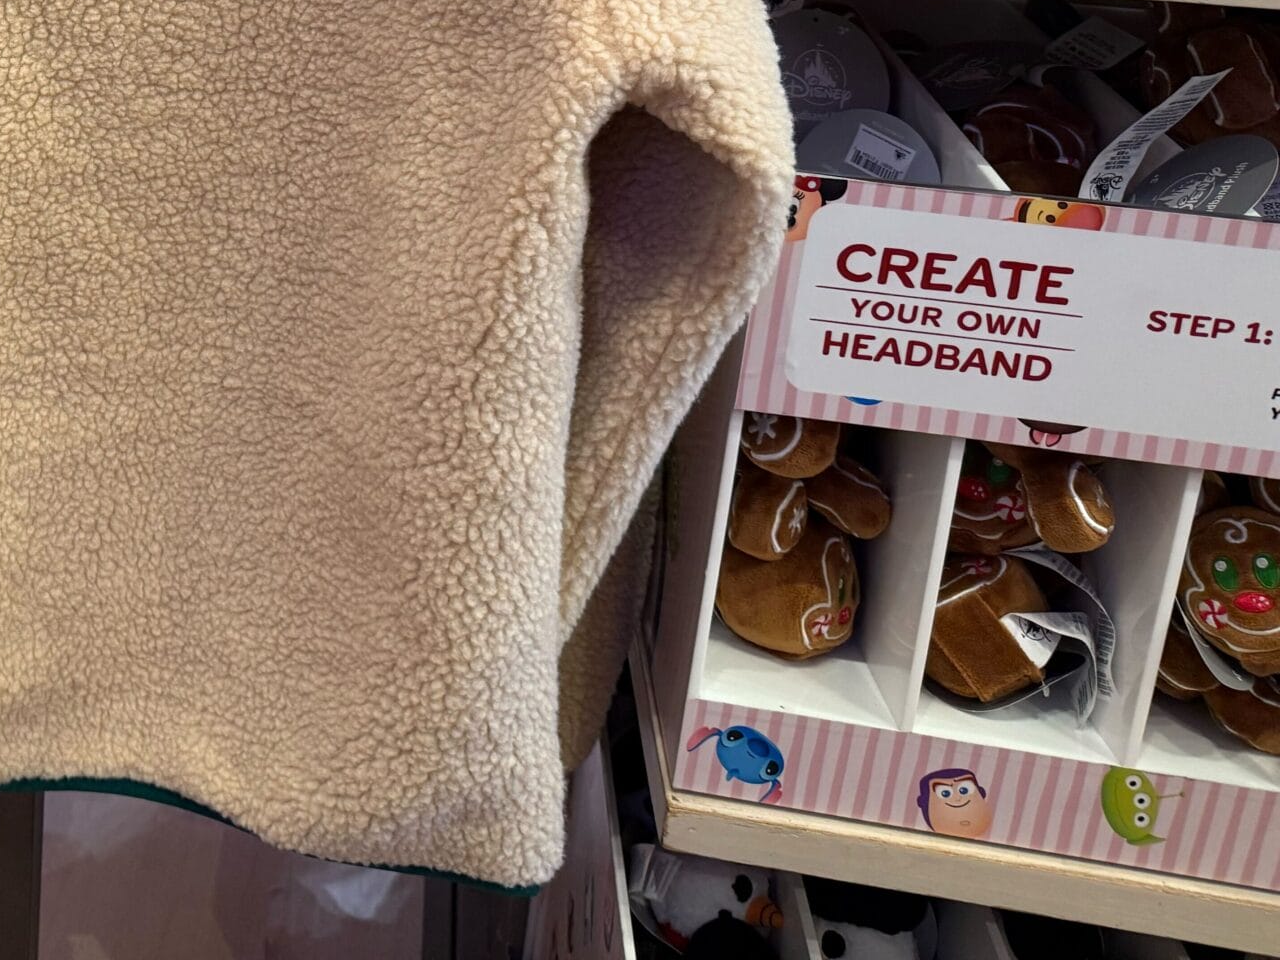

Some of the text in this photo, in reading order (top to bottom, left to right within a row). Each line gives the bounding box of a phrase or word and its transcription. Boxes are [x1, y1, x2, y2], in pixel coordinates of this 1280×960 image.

[836, 243, 1074, 305] CREATE
[850, 298, 1041, 339] YOUR OWN
[1146, 310, 1274, 345] STEP 1:
[822, 330, 1052, 382] HEADBAND
